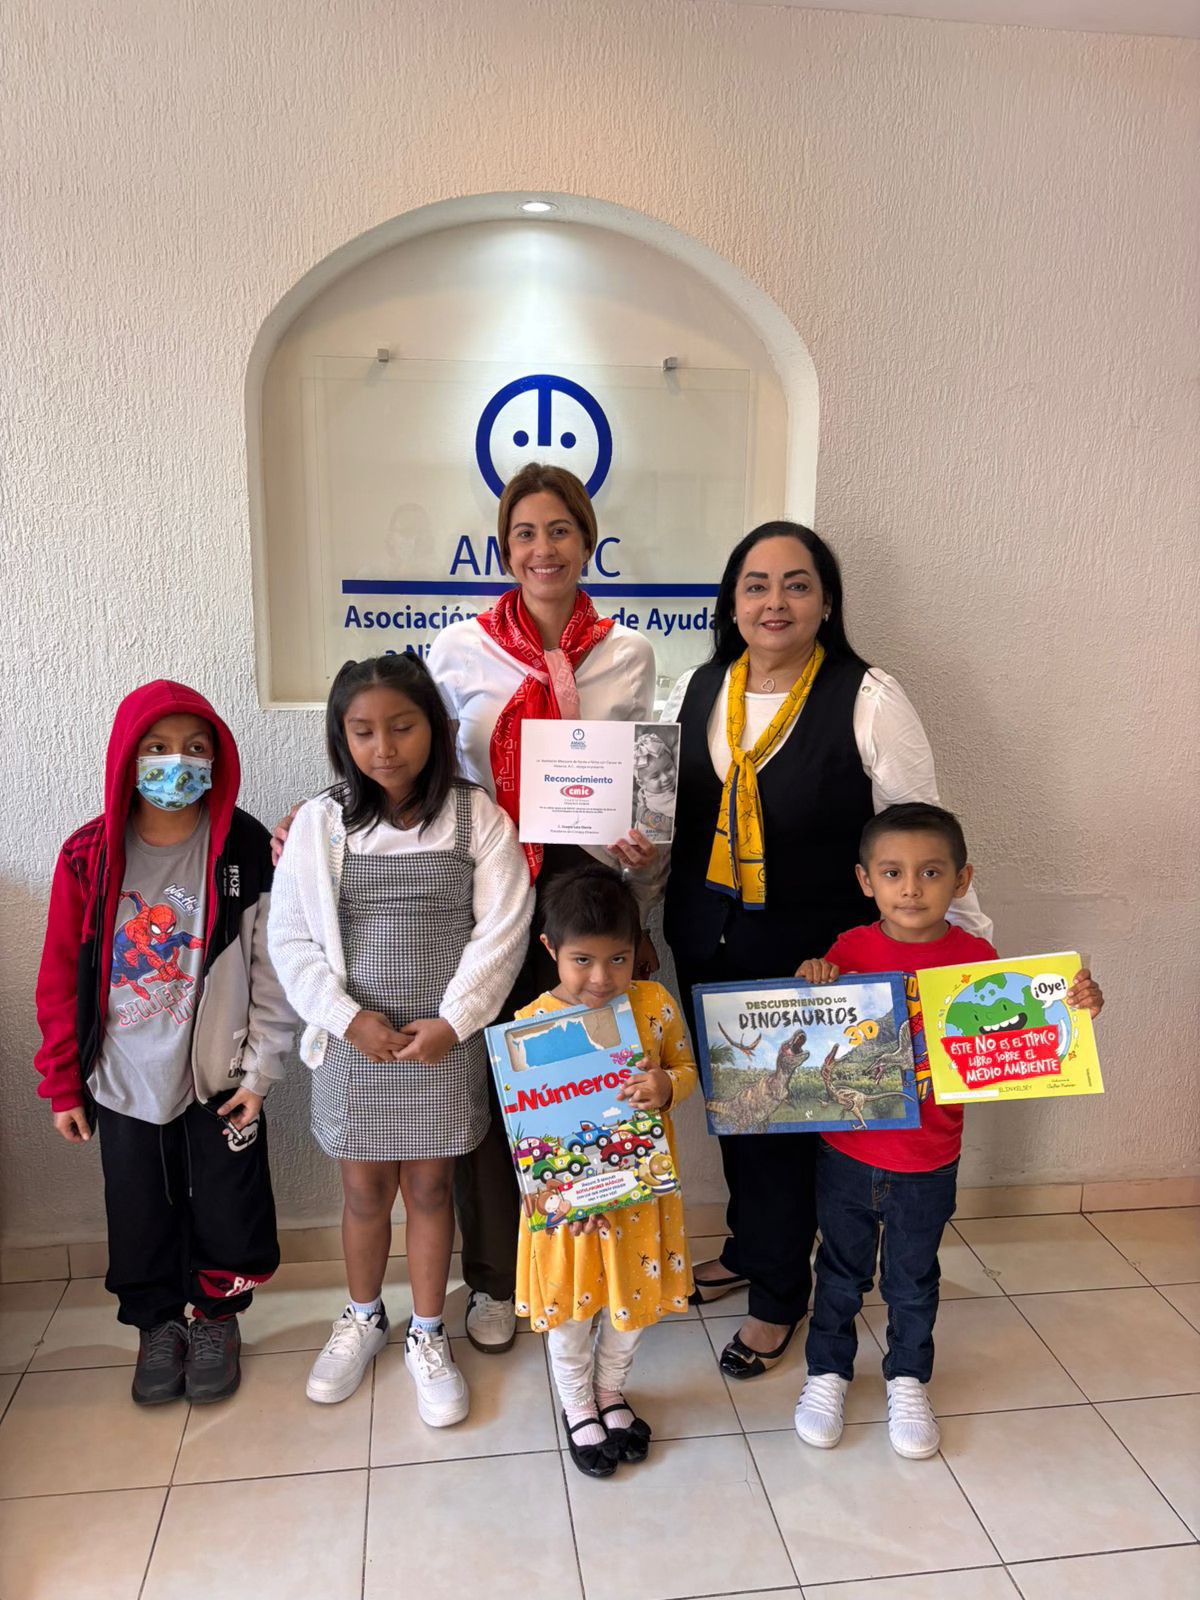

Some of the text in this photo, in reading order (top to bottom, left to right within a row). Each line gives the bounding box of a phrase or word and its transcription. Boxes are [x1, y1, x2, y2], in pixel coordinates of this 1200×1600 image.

[450, 534, 621, 577] AMC
[613, 607, 640, 630] de
[544, 774, 613, 784] Reconocimiento
[568, 785, 590, 796] cmic
[1033, 978, 1067, 998] ¡Oye!
[745, 997, 833, 1011] DESCUBRIENDO
[738, 1006, 859, 1030] DINOSAURIOS
[843, 1019, 880, 1047] 3D
[975, 1036, 996, 1054] NO
[1000, 1039, 1010, 1050] ES
[1012, 1037, 1022, 1048] EL
[968, 1049, 1037, 1067] LIBRO SOBRE EL
[966, 1058, 1060, 1083] MEDIO AMBIENTE
[516, 1068, 633, 1111] Números
